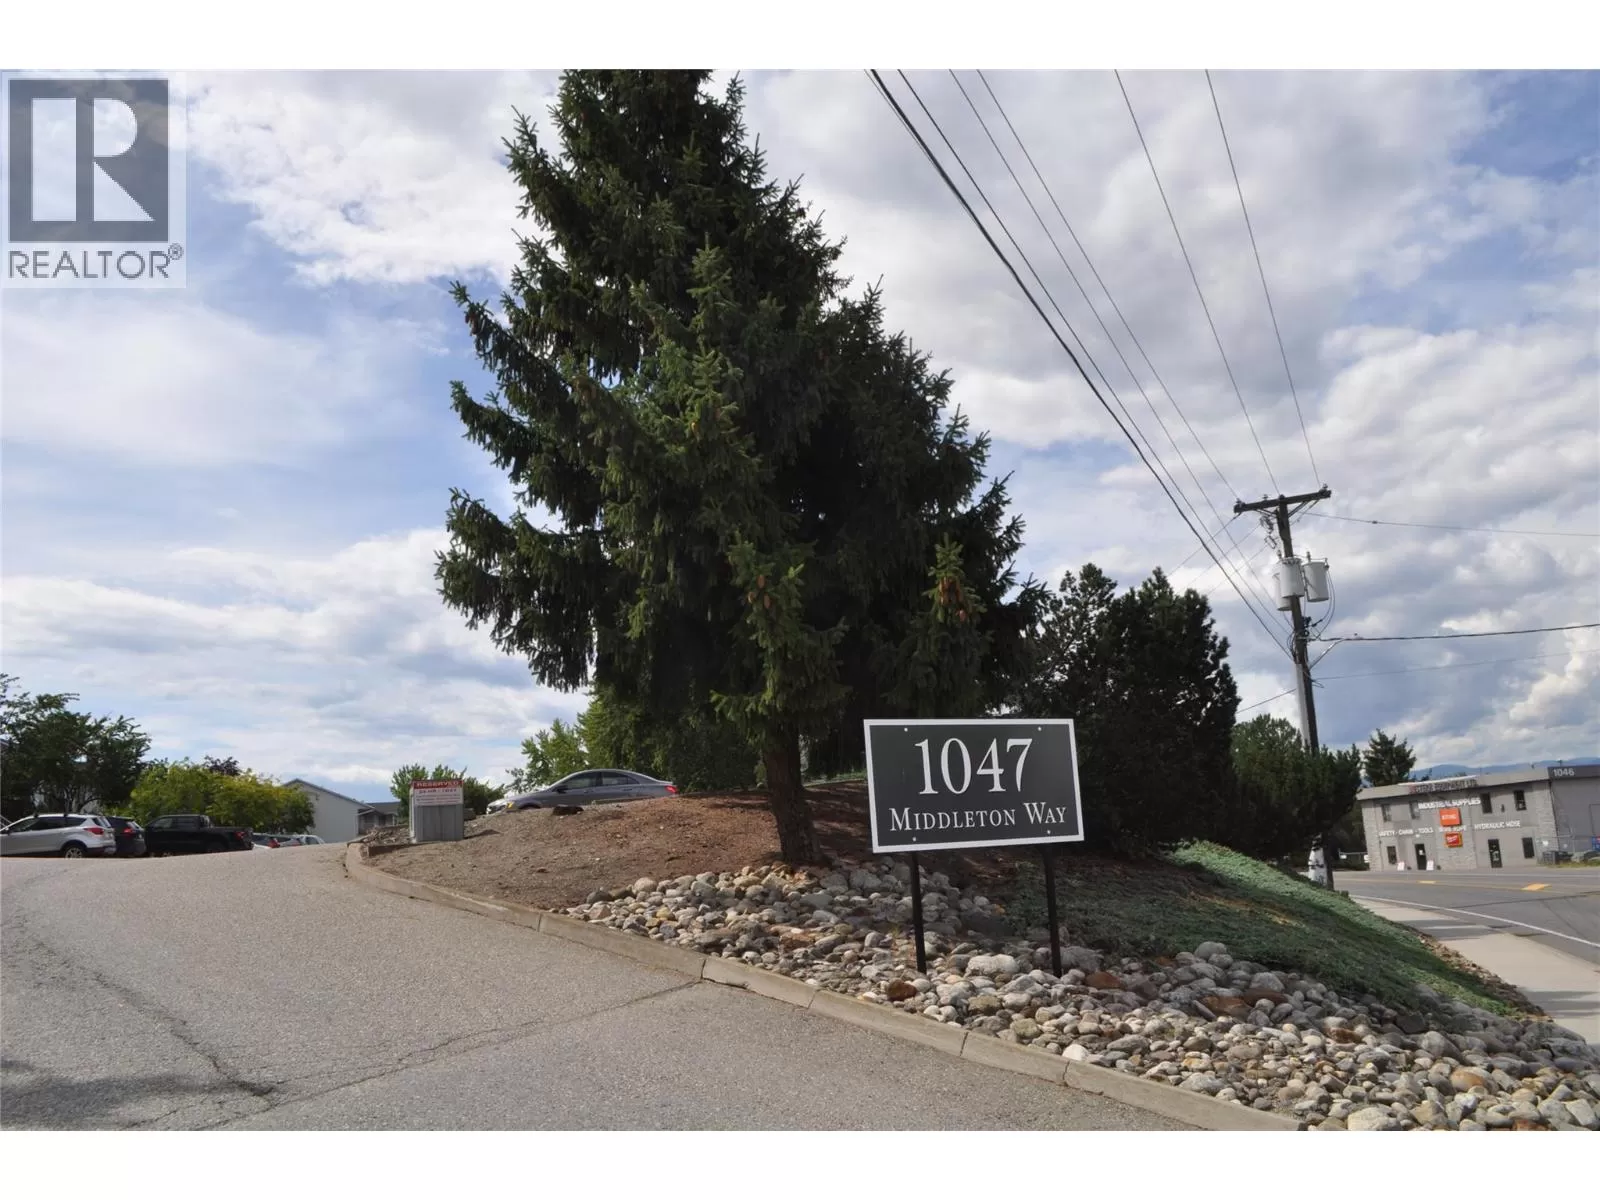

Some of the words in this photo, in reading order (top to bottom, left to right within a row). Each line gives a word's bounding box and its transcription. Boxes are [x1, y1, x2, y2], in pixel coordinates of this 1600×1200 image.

[914, 737, 1033, 795] 1047
[1452, 797, 1481, 807] SUPPLIES
[1474, 821, 1504, 830] HYDRAULIC
[1505, 819, 1521, 828] HOSE
